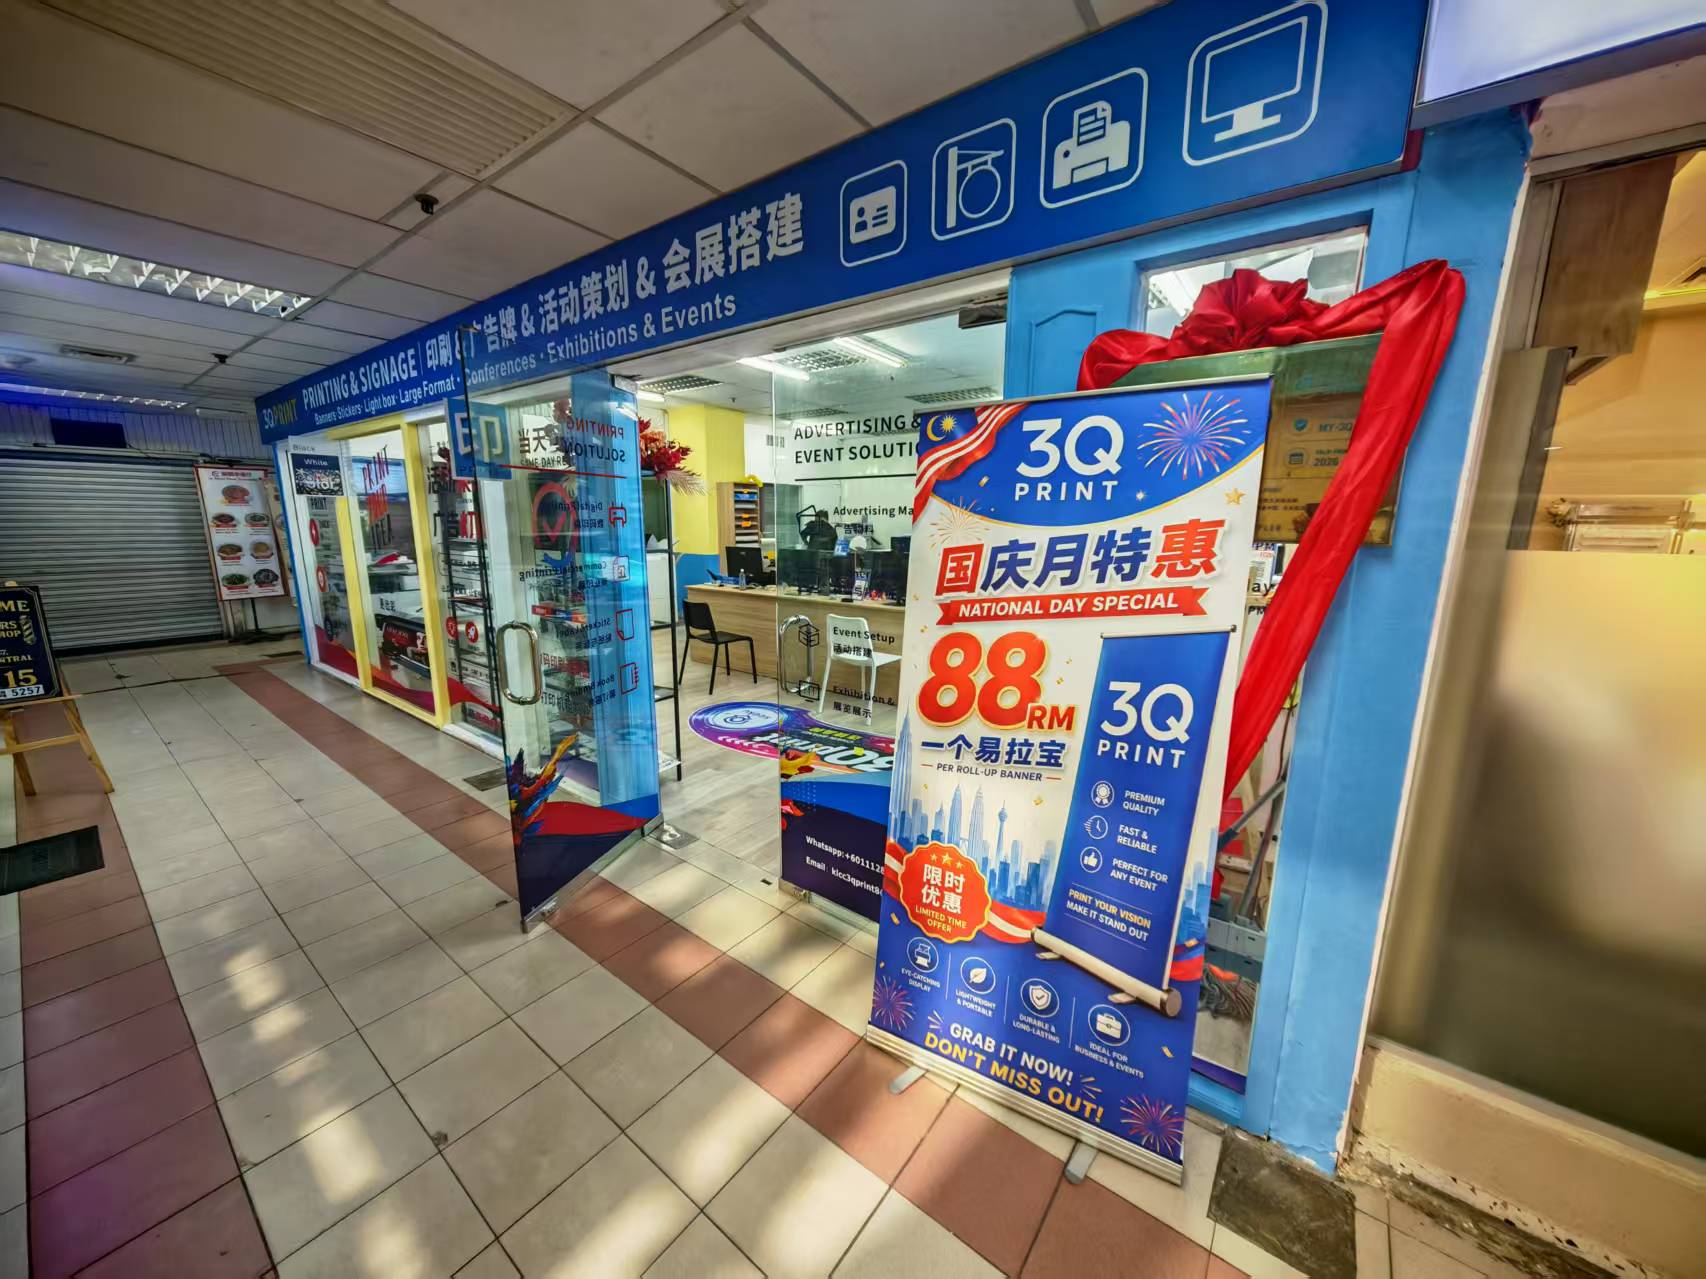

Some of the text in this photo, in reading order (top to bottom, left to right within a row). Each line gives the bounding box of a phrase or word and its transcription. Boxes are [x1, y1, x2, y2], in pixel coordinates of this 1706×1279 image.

[425, 331, 453, 371] 印刷
[469, 309, 517, 358] 广告牌
[521, 303, 535, 337] &
[538, 259, 629, 336] 活动策划
[635, 256, 656, 299] &
[662, 192, 804, 294] 会展搭建
[314, 292, 737, 425] Banners Stickers Light box Large Format Conferences Exhibitions & Events
[302, 348, 418, 410] PRINTING & SIGNAGE
[262, 399, 298, 429] 3QPRINT
[794, 414, 921, 440] ADVERTISING &
[795, 447, 844, 464] EVENT
[1016, 415, 1124, 478] 3Q
[303, 458, 328, 466] White
[1014, 480, 1119, 502] PRINT
[833, 505, 896, 519] Advertising
[935, 518, 1226, 597] 国庆月特惠
[958, 591, 1179, 618] NATIONAL DAY SPECIAL
[833, 626, 896, 645] Event Setup
[4, 669, 37, 688] 15
[916, 630, 1076, 730] 88 RM
[11, 686, 41, 697] 5257
[833, 685, 895, 706] Exhibition &
[833, 701, 872, 718] 展览展示
[1100, 681, 1194, 744] 3Q
[921, 734, 1066, 768] 一个易拉宝
[1097, 739, 1186, 769] PRINT
[936, 763, 1043, 781] PER ROLL-UP BANNER
[1122, 800, 1159, 816] QUALITY
[1124, 789, 1166, 806] PREMIUM
[1119, 824, 1148, 840] FAST &
[1117, 835, 1158, 855] RELIABLE
[922, 863, 965, 893] 限时
[1110, 869, 1157, 892] ANY EVENT
[1112, 858, 1168, 883] PERFECT FOR
[921, 884, 963, 915] 优惠
[1068, 888, 1151, 929] PRINT YOUR VISION
[915, 905, 967, 929] LIMITED TIME
[927, 920, 952, 934] OFFER
[1066, 900, 1149, 941] MAKE IT STAND OUT
[901, 968, 940, 988] EYE-CATCHING
[908, 978, 931, 992] DISPLAY
[955, 989, 996, 1010] LIGHTWEIGHT
[956, 998, 993, 1017] & PORTABLE
[1012, 1020, 1060, 1044] LONG-LASTING
[1019, 1013, 1056, 1033] DURABLE &
[950, 1022, 1074, 1086] GRAB IT NOW!
[1074, 1044, 1144, 1079] BUSINESS & EVENTS
[1089, 1041, 1129, 1063] IDEAL FOR
[924, 1031, 1105, 1123] DON'T MISS OUT!
